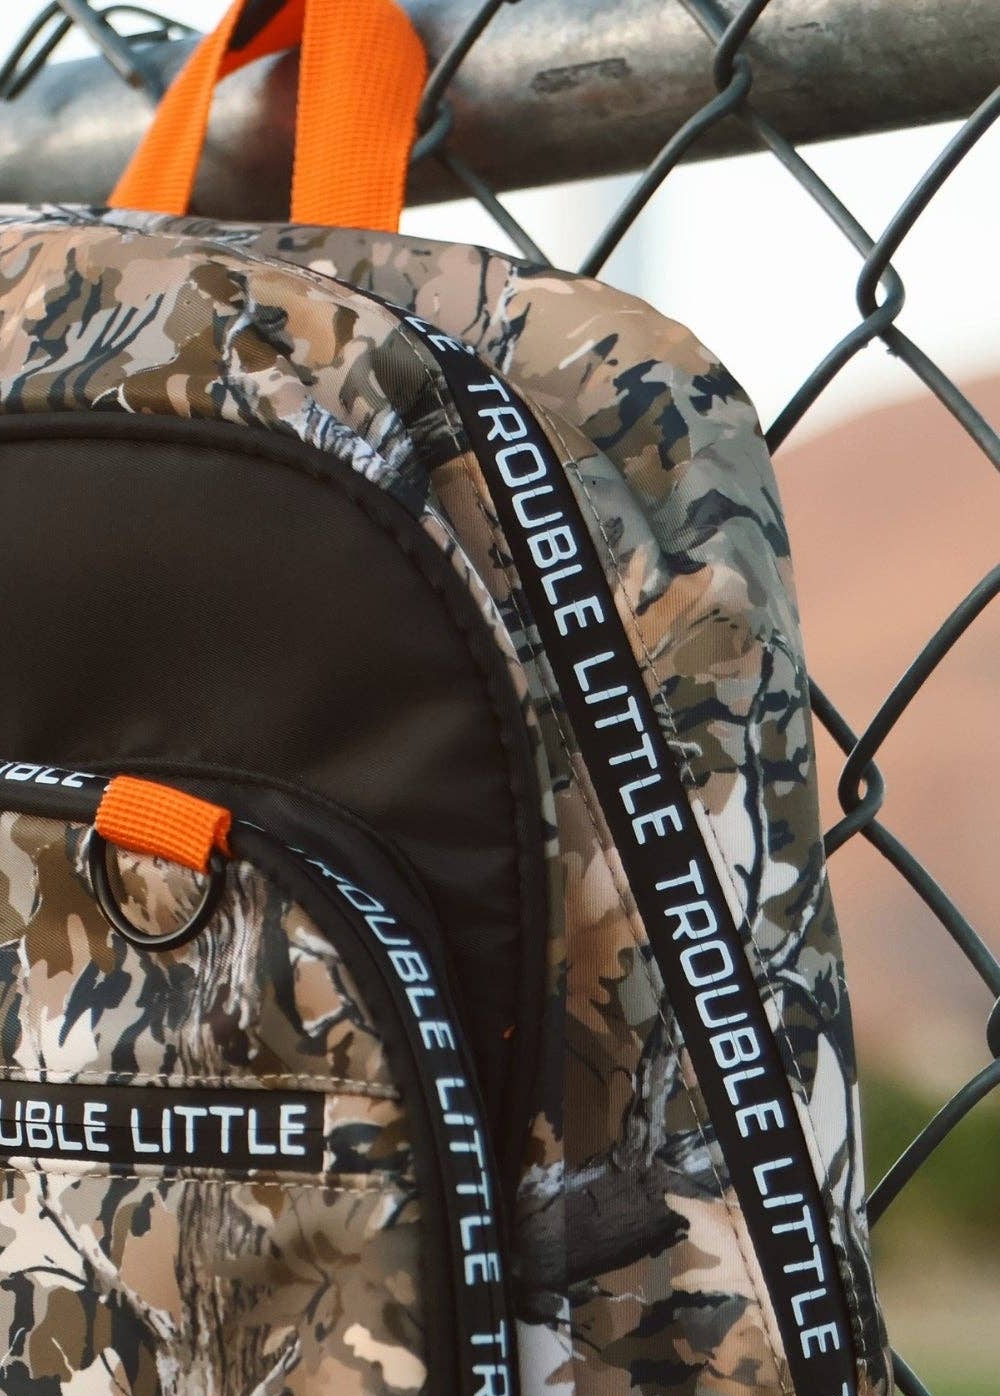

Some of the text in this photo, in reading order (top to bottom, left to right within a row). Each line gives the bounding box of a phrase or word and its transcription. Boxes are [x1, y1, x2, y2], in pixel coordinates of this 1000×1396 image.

[468, 375, 605, 636] TROUBLE
[572, 650, 683, 846] LITTLE
[655, 859, 785, 1138] TROUBLE
[753, 1157, 840, 1359] LITTLE
[130, 1103, 307, 1156] LITTLE
[434, 1077, 500, 1287] LITTLE
